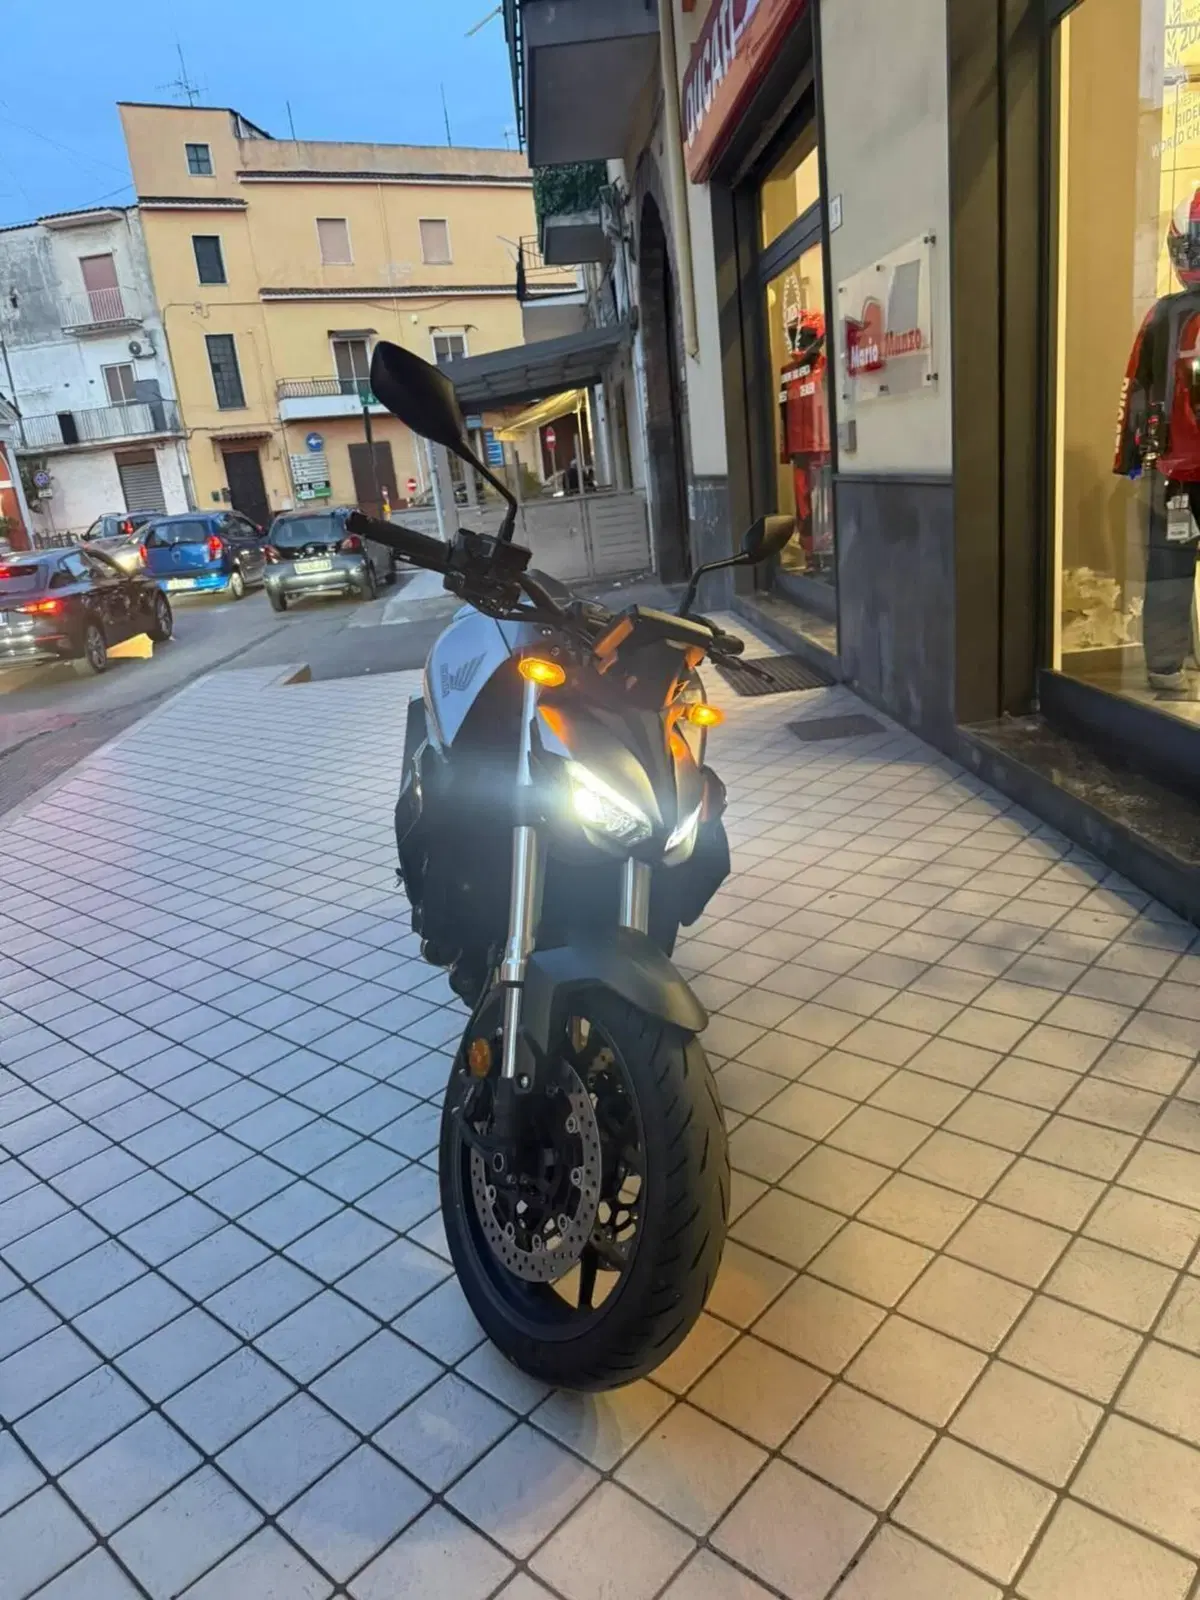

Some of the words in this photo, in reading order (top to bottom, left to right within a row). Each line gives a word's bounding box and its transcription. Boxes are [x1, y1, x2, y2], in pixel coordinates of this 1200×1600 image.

[1180, 25, 1200, 51] 20
[686, 0, 737, 148] DUCATI
[1177, 102, 1200, 127] RIDE
[1151, 130, 1185, 160] WORLD
